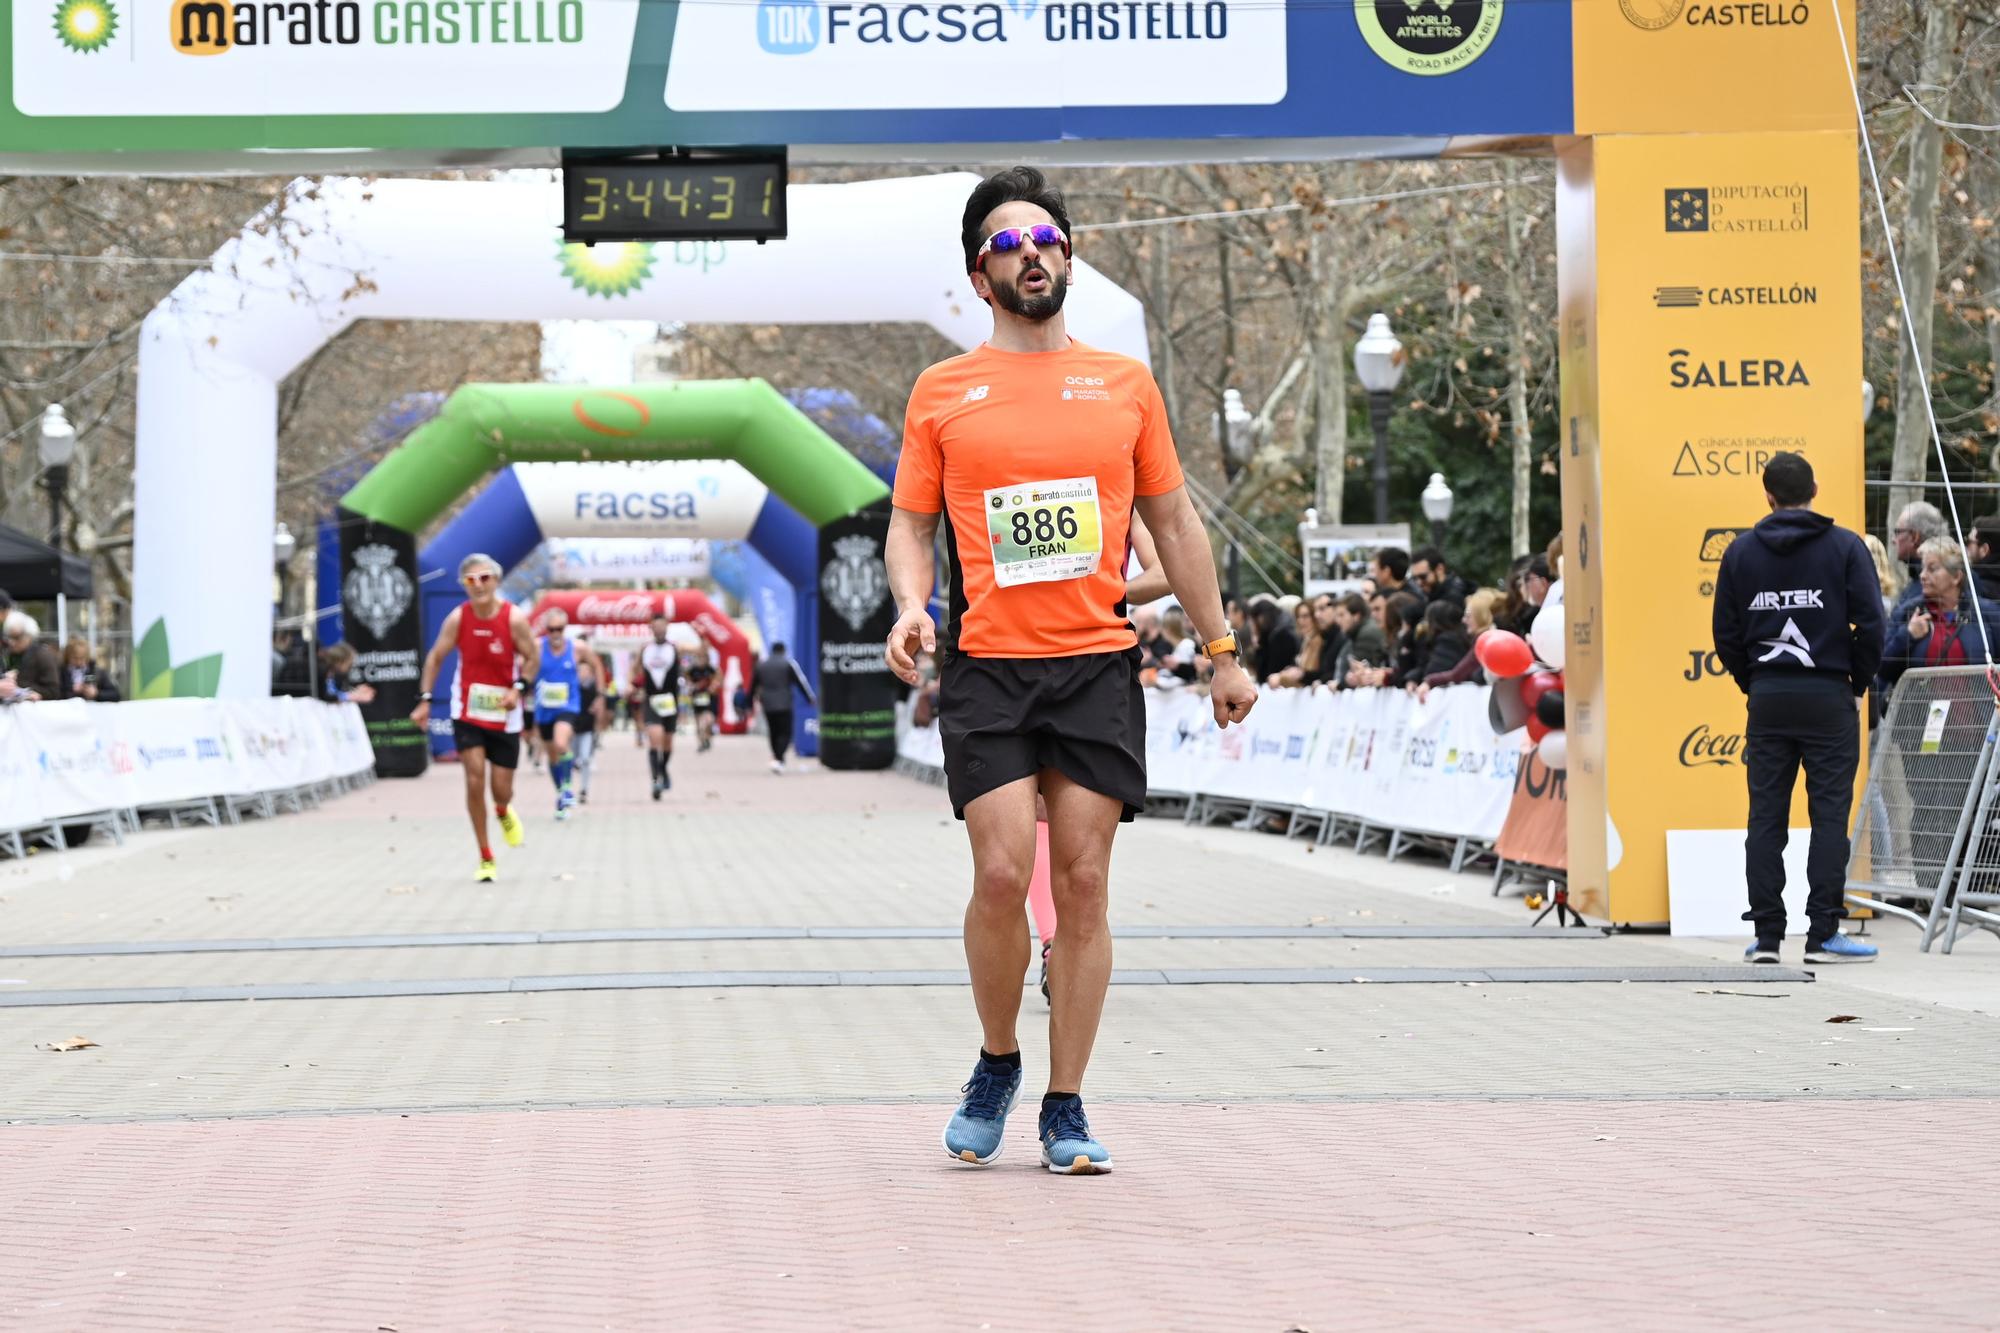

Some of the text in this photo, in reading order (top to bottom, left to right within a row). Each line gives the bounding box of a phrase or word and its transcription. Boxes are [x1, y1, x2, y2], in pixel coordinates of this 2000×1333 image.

[764, 5, 813, 44] 10K
[1406, 15, 1452, 26] WORLD
[1396, 26, 1463, 38] ATHLETICS
[1407, 13, 1497, 69] ROAD RACE LABEL
[1711, 182, 1802, 199] DIPUTACIÓ
[1708, 282, 1817, 304] CASTELLÓN
[1065, 376, 1104, 386] acea
[1699, 435, 1807, 448] CLÍNICAS BIOMÉDICAS
[1672, 440, 1804, 476] ASCIR
[1011, 505, 1078, 546] 886
[1029, 541, 1067, 558] FRAN
[1748, 589, 1823, 611] AIRTEK
